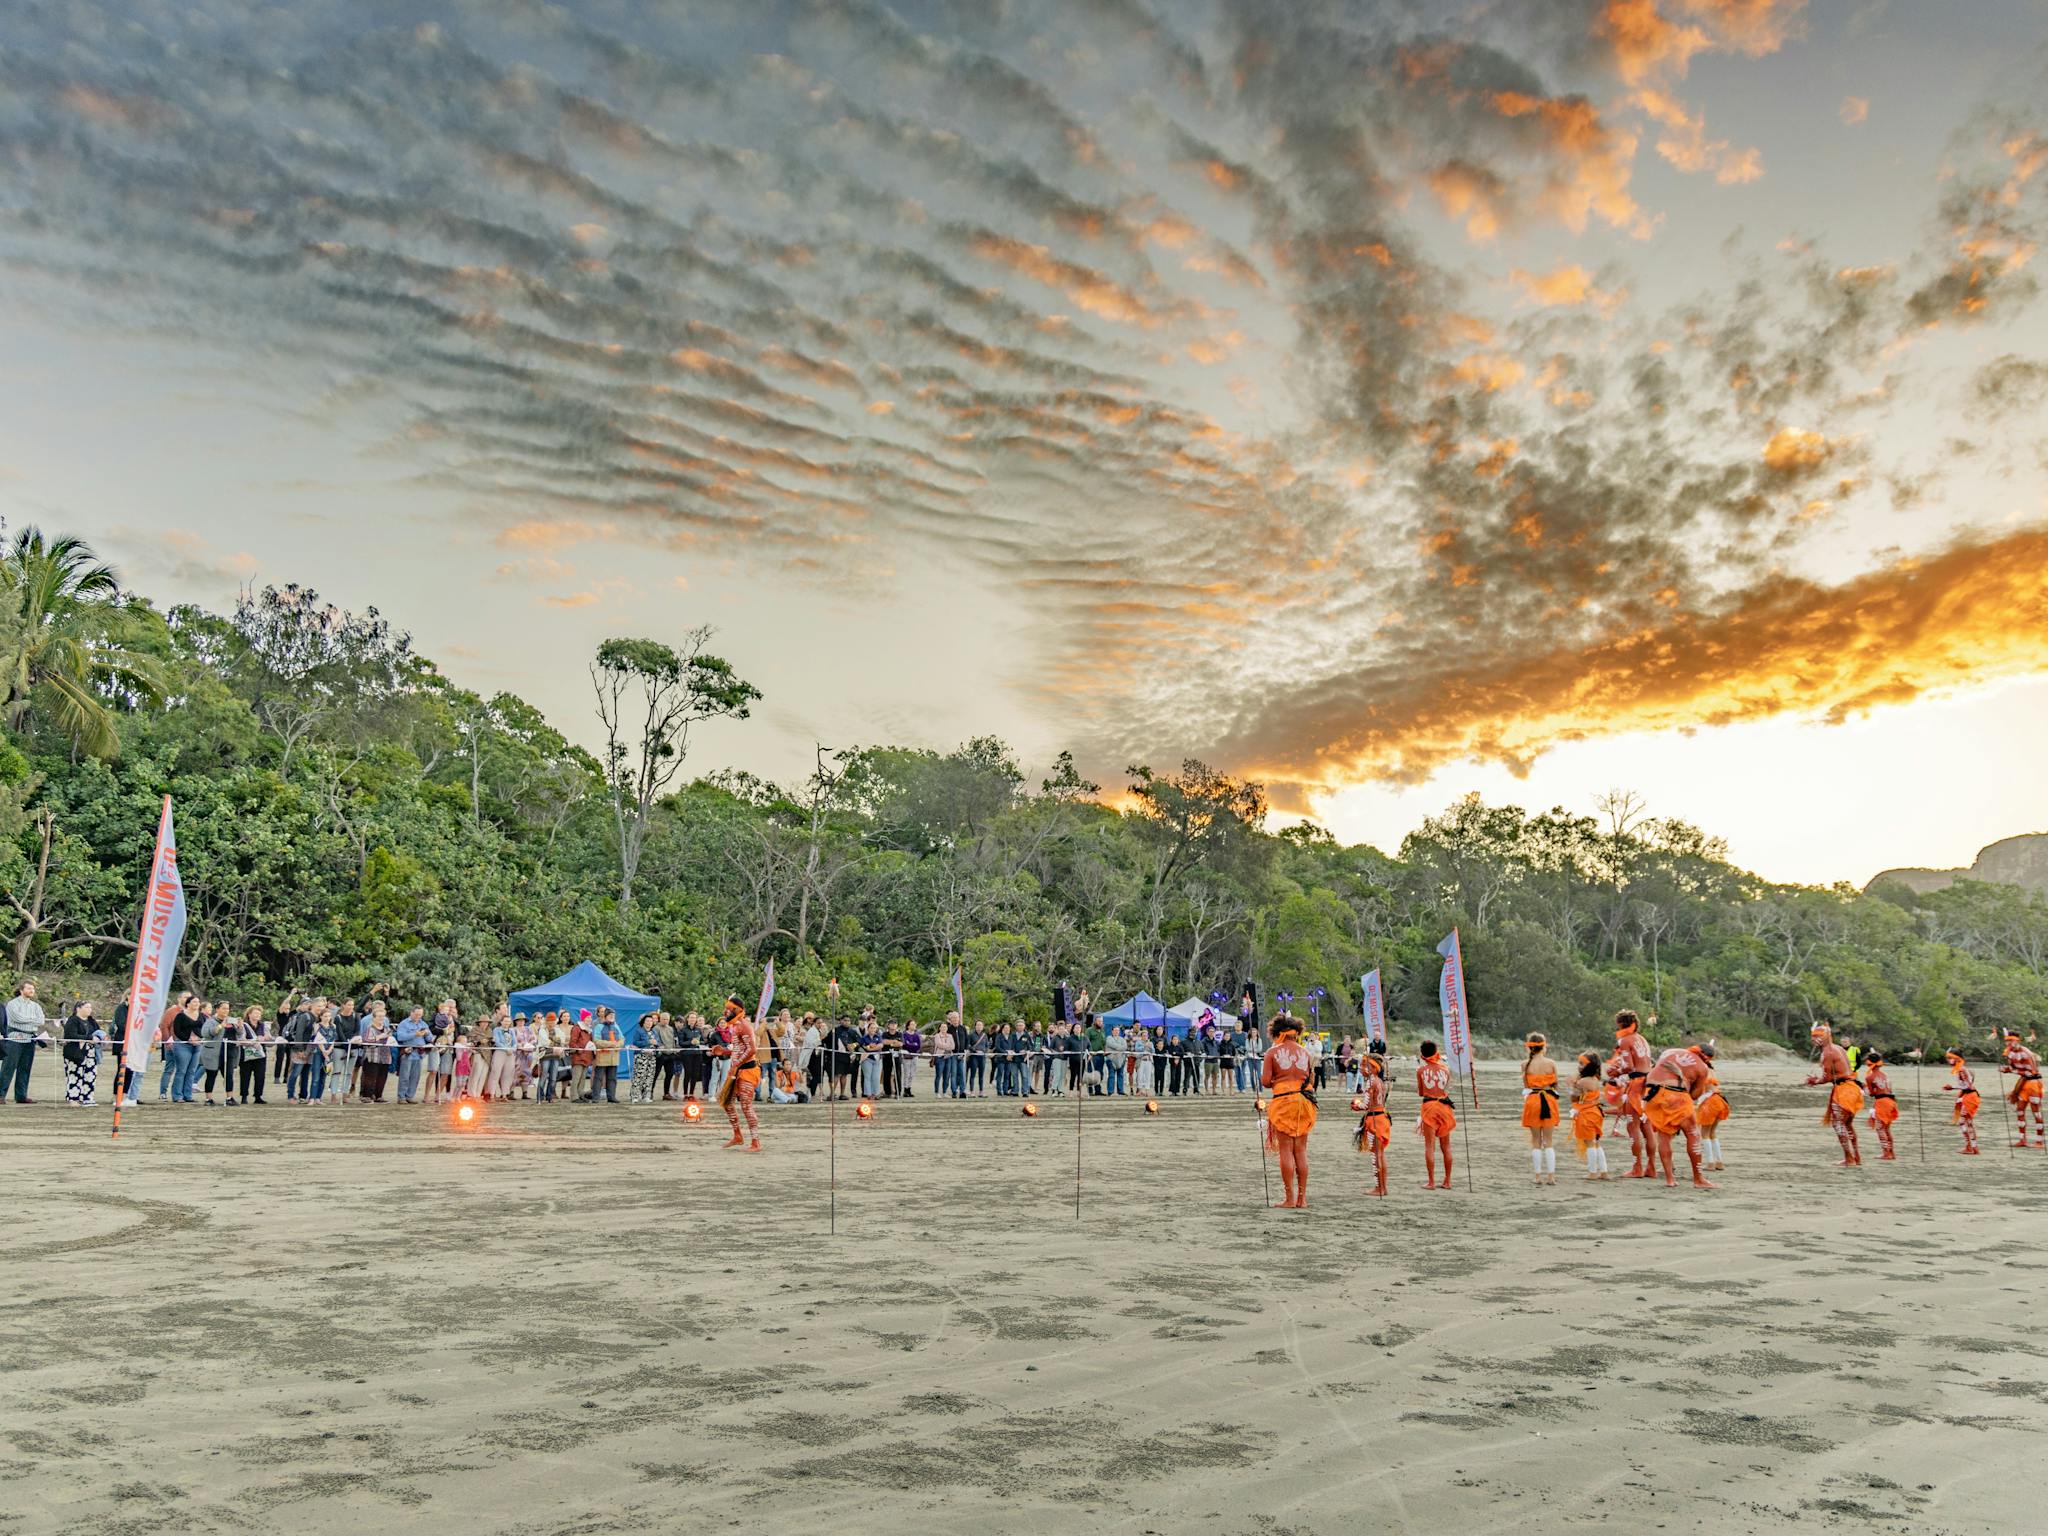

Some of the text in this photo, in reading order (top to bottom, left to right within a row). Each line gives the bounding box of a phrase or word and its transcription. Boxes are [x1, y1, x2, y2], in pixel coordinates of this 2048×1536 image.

[150, 881, 177, 950] MUSIC
[134, 954, 160, 1030] TRAILS
[1445, 973, 1459, 1011] MUSIC
